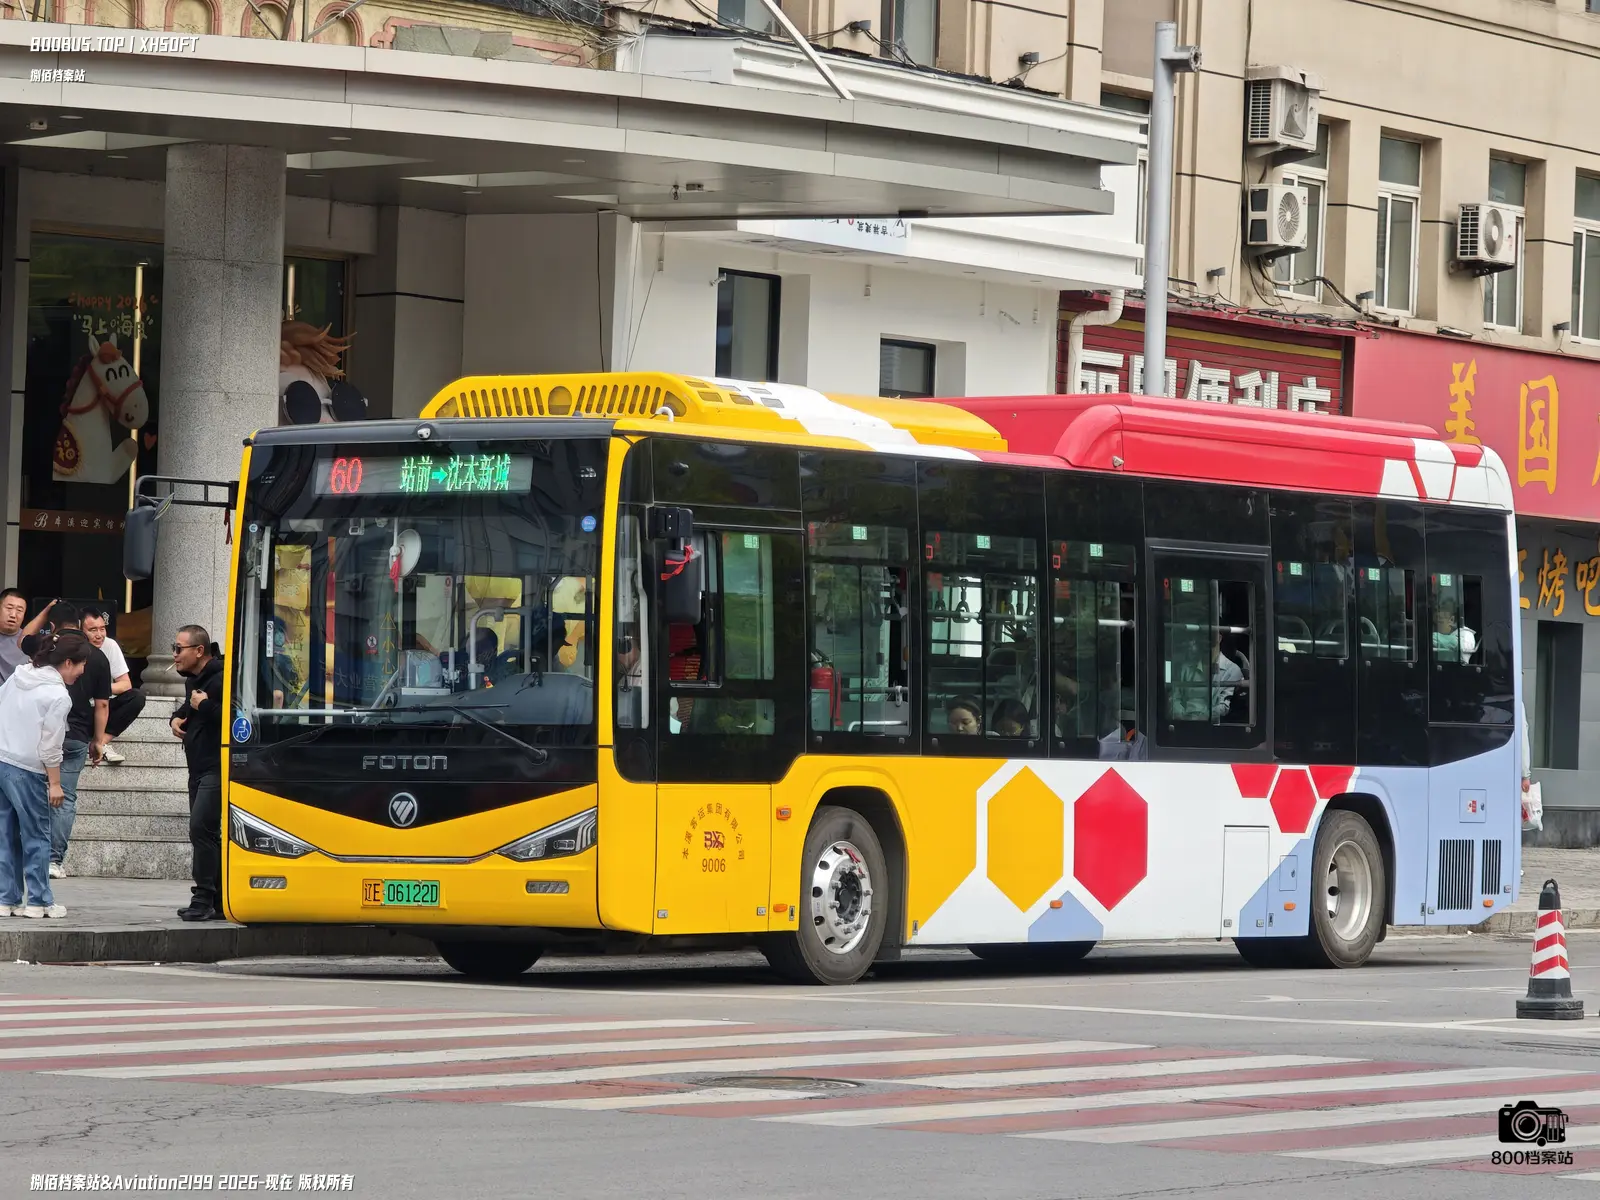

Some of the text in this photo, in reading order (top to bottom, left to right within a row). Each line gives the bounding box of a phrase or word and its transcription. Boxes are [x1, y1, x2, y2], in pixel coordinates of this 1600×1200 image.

[1444, 358, 1600, 495] 美国
[331, 458, 363, 494] 60
[400, 453, 511, 493] 站前 沈本新城
[362, 755, 448, 770] FOTON
[702, 858, 726, 873] 9006
